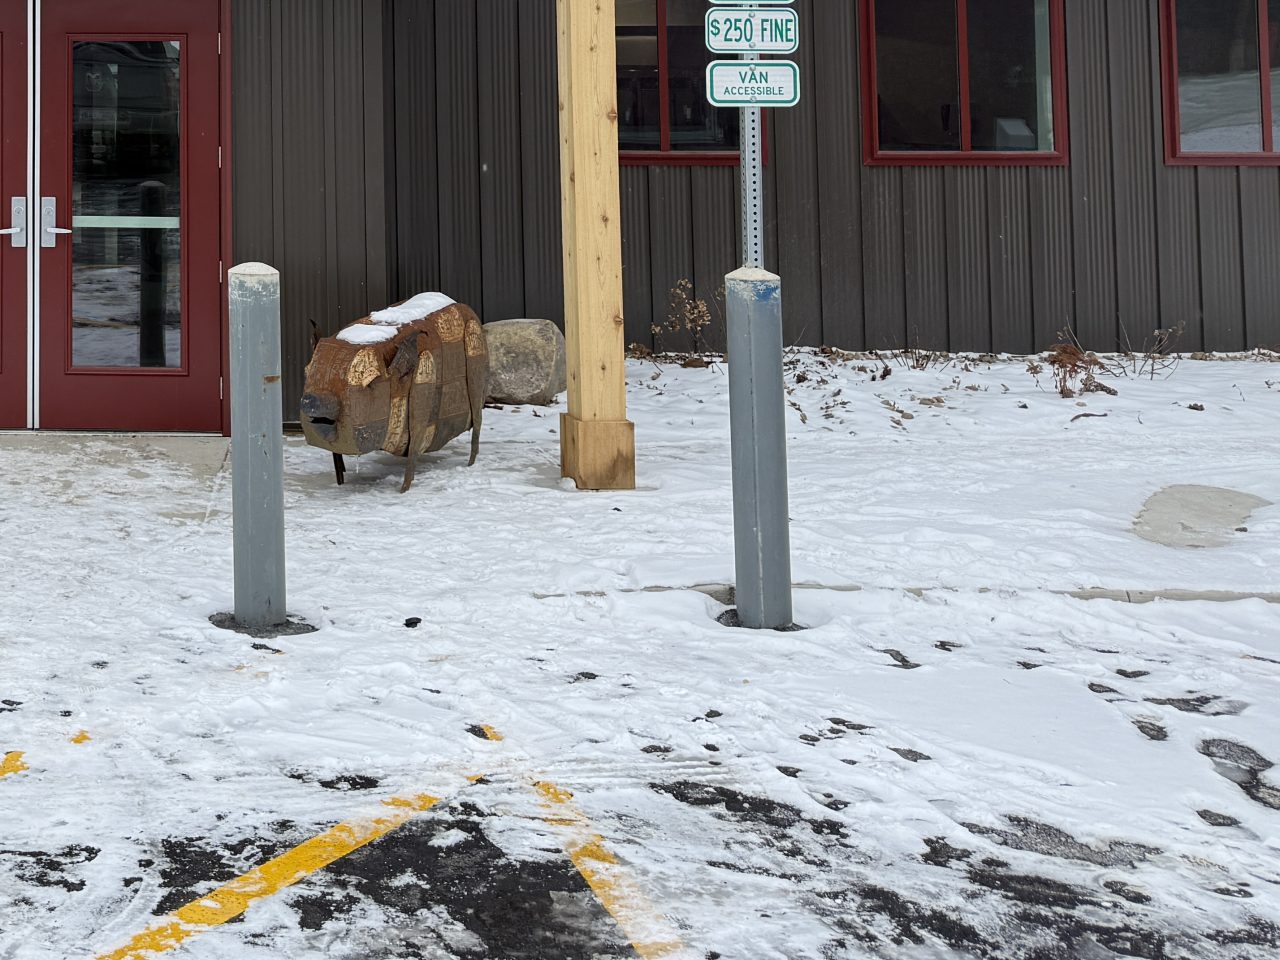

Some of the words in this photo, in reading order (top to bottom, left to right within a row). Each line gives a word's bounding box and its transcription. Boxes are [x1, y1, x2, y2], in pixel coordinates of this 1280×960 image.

[760, 18, 794, 43] FINE
[738, 71, 769, 84] VAN
[723, 86, 785, 96] ACCESSIBLE
